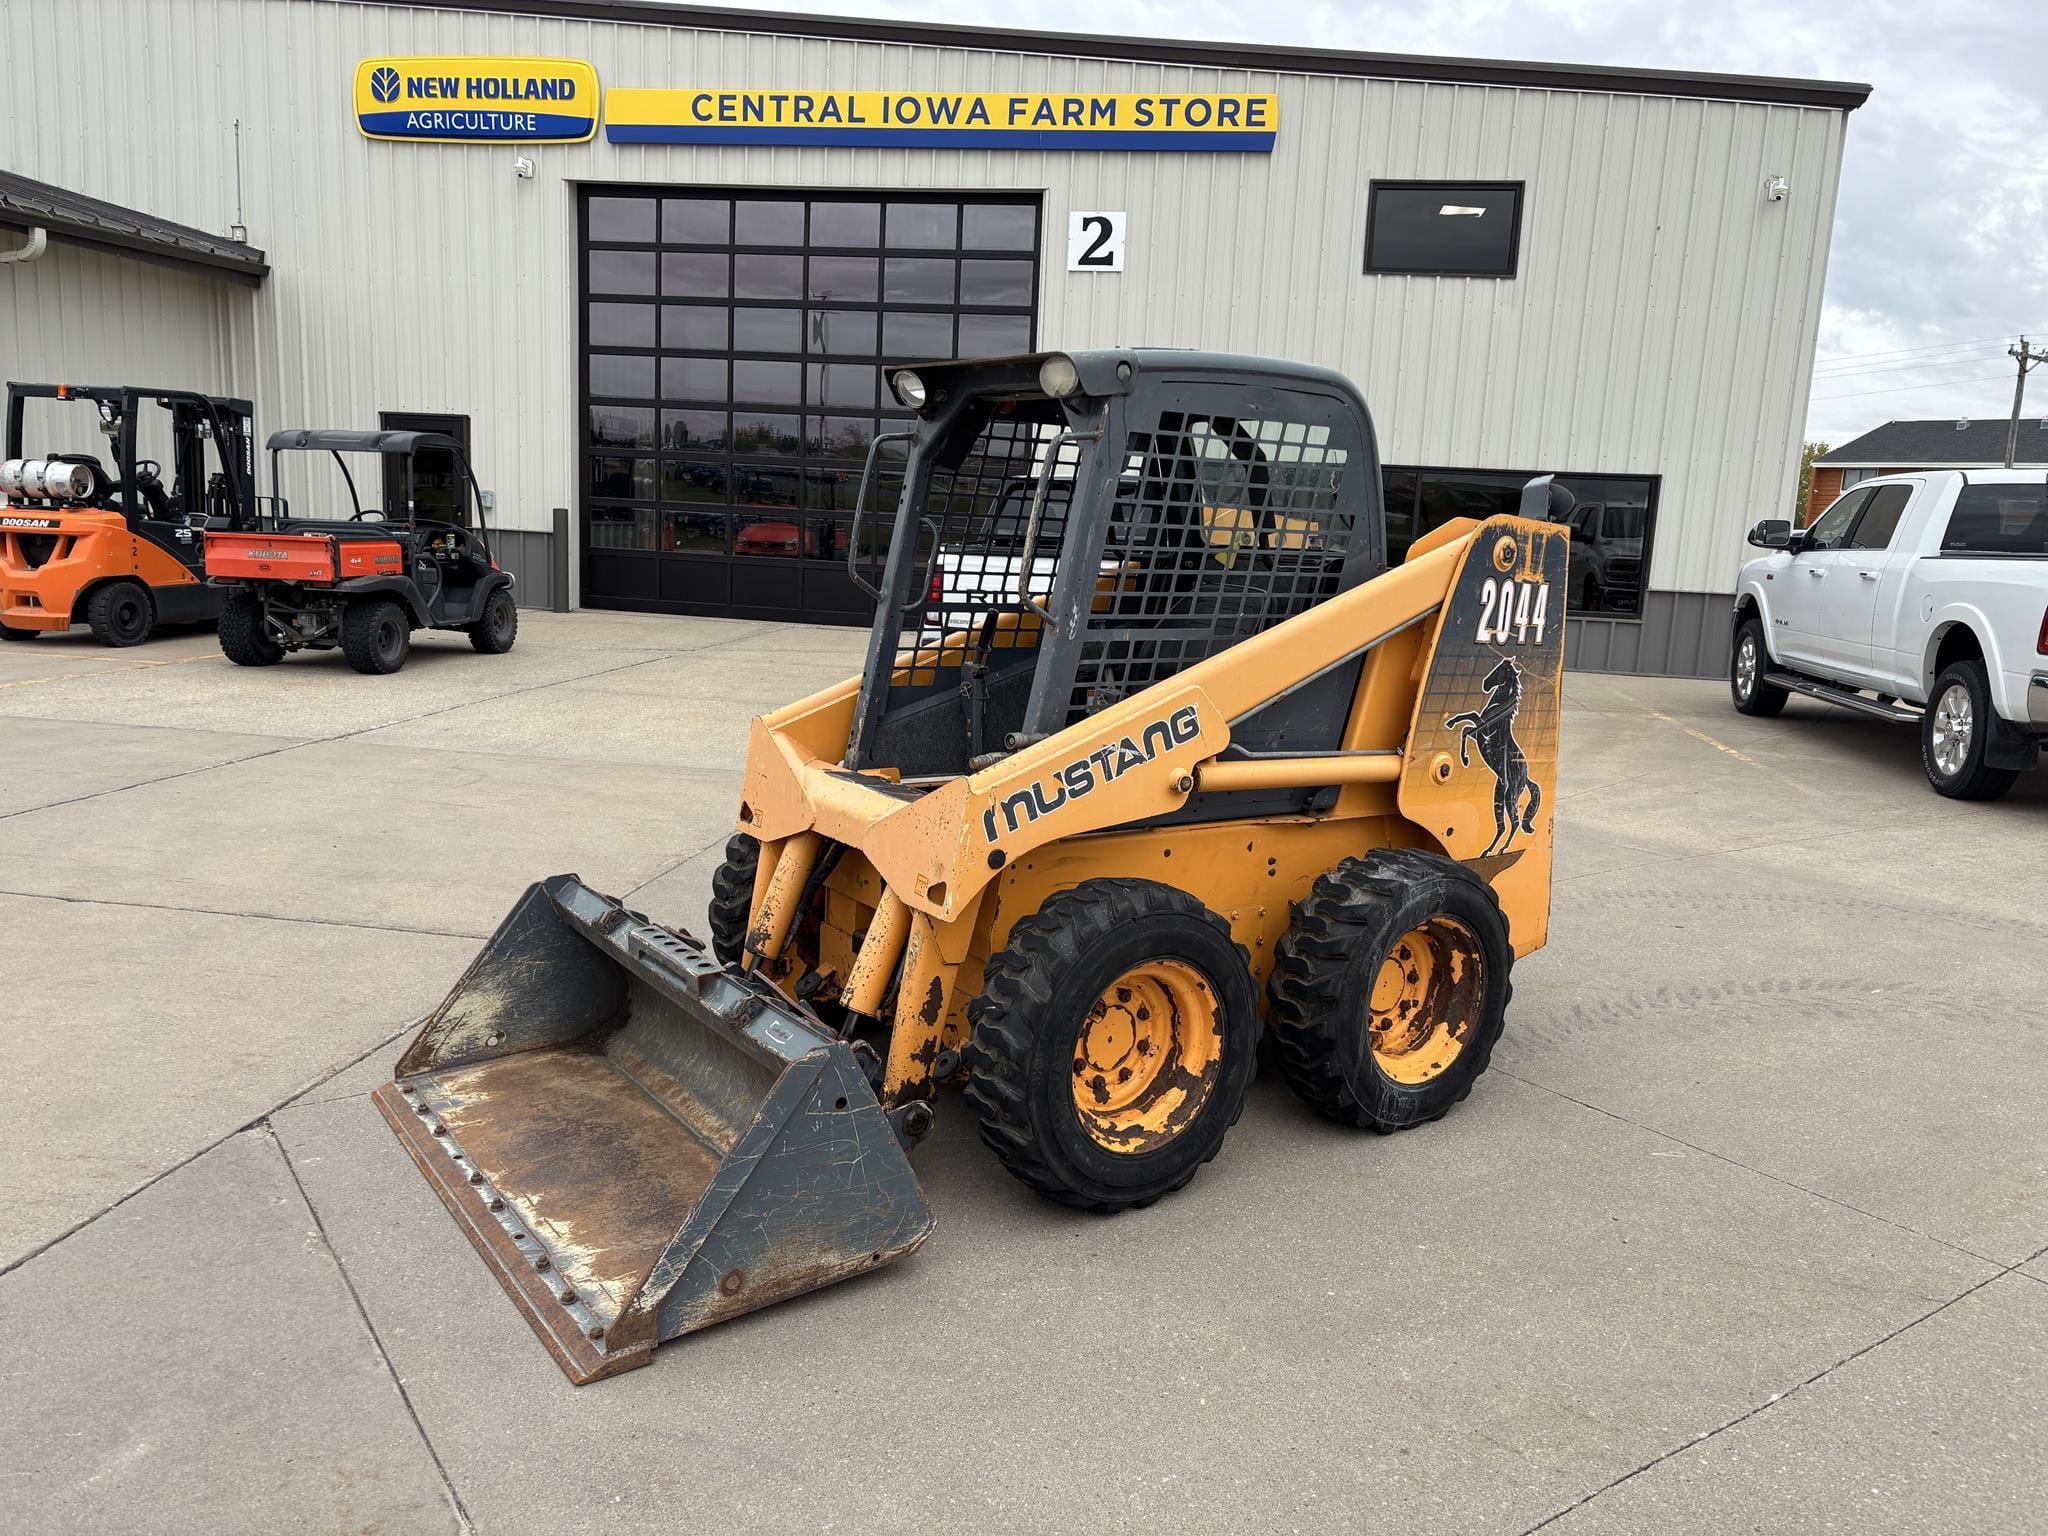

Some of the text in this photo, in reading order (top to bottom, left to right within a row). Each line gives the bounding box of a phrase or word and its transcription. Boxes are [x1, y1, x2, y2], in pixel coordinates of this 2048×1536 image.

[406, 77, 576, 100] NEW HOLLAND
[406, 112, 537, 131] AGRICULTURE
[691, 93, 1267, 127] CENTRAL IOWA FARM STORE
[1077, 216, 1115, 266] 2
[244, 436, 252, 475] DOOSAN
[1, 517, 50, 528] DOOSAN
[174, 528, 193, 538] 25
[248, 550, 289, 560] KUBOTA
[1474, 575, 1551, 645] 2044
[982, 703, 1201, 844] MUSTANG
